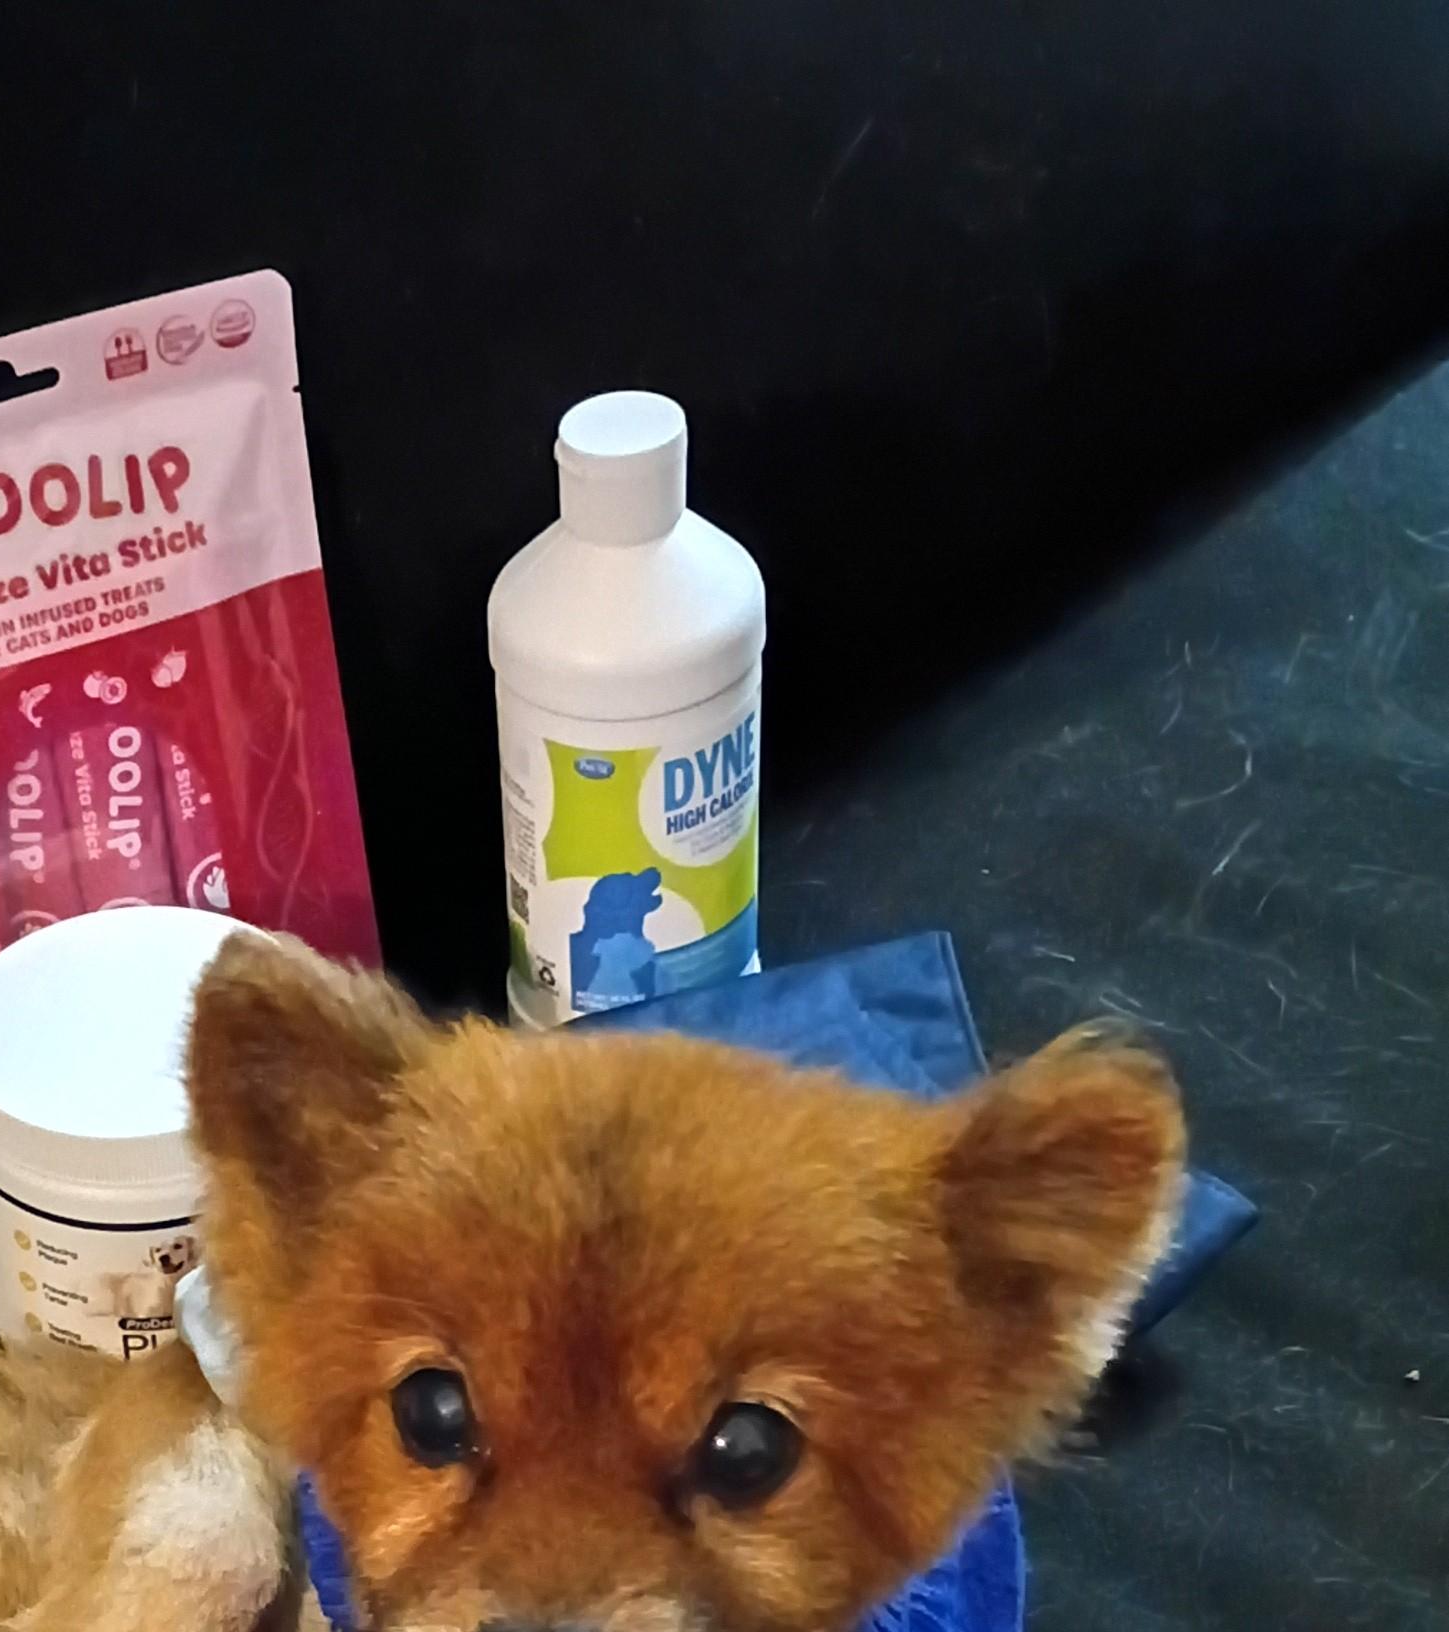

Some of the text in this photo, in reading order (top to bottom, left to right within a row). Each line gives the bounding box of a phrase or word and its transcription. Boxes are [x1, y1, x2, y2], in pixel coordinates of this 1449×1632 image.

[36, 552, 111, 590] Vita
[118, 520, 208, 568] Stick
[6, 626, 52, 655] CATS
[55, 619, 94, 642] AND
[99, 601, 150, 629] DOGS
[19, 597, 97, 631] INFUSED
[101, 576, 166, 607] TREATS
[664, 712, 756, 813] DYNE
[175, 768, 198, 820] Stick
[666, 804, 706, 835] HIGH
[82, 810, 102, 860] Stick
